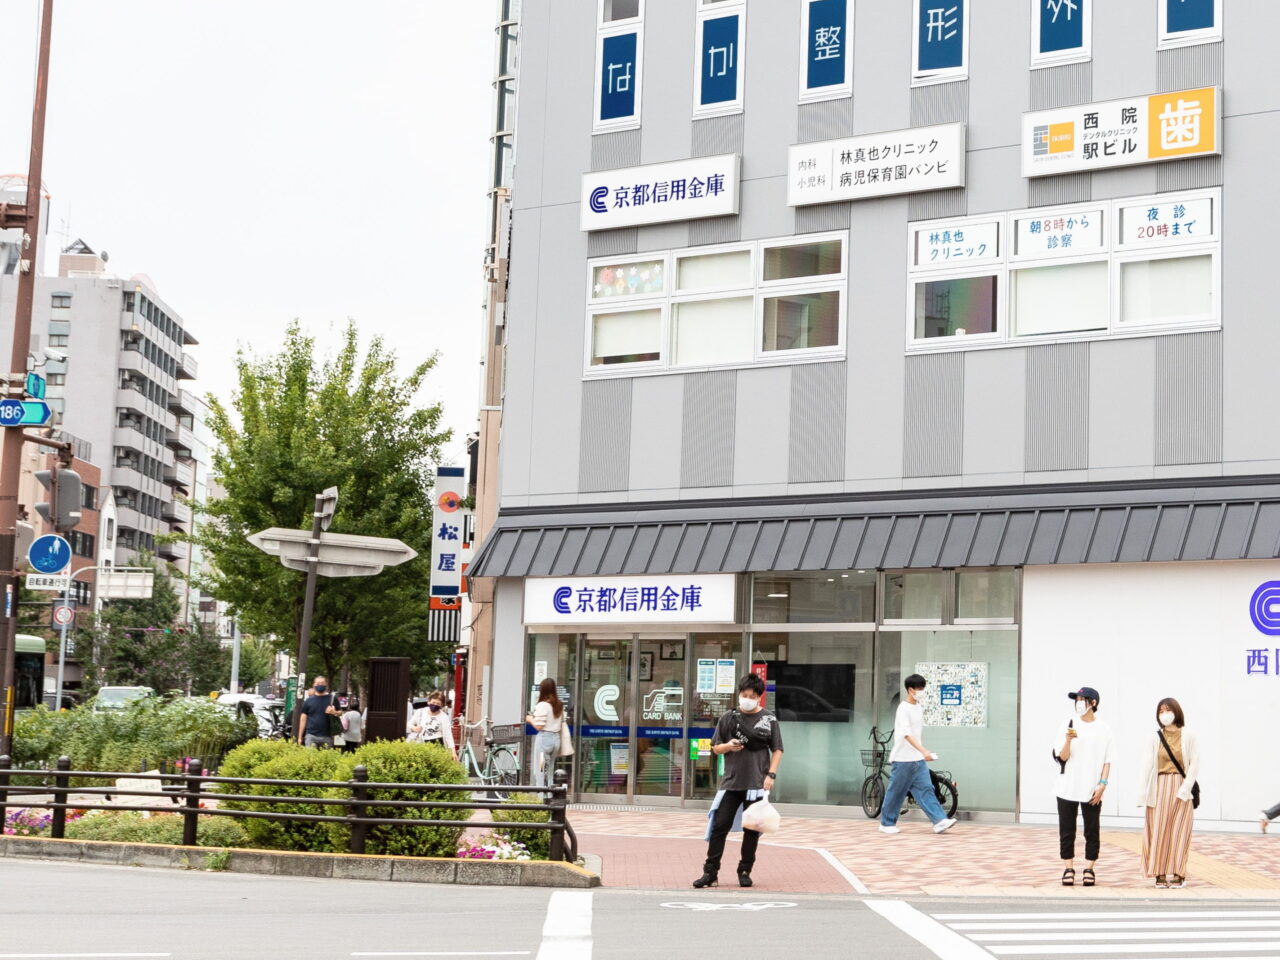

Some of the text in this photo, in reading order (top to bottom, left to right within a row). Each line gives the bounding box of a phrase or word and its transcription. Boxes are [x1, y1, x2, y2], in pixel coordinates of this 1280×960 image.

[1083, 106, 1138, 130] 西院
[1158, 99, 1202, 150] 歯
[839, 138, 938, 166] 林真也クリニック
[1082, 137, 1138, 160] 駅ビル
[797, 157, 816, 171] 内科
[839, 160, 949, 188] 病児保育園バンビ
[612, 172, 726, 210] 京都信用金庫
[797, 174, 827, 189] 小児科
[1146, 203, 1188, 222] 夜診
[1029, 215, 1090, 235] 朝8時から
[1136, 219, 1197, 240] 20時まで
[928, 230, 965, 245] 林真也
[1047, 233, 1073, 249] 診察
[929, 243, 987, 261] クリニック
[0, 405, 22, 419] 186
[437, 522, 459, 572] 松屋
[575, 584, 703, 613] 京都信用金庫
[642, 712, 682, 720] CARD BANK
